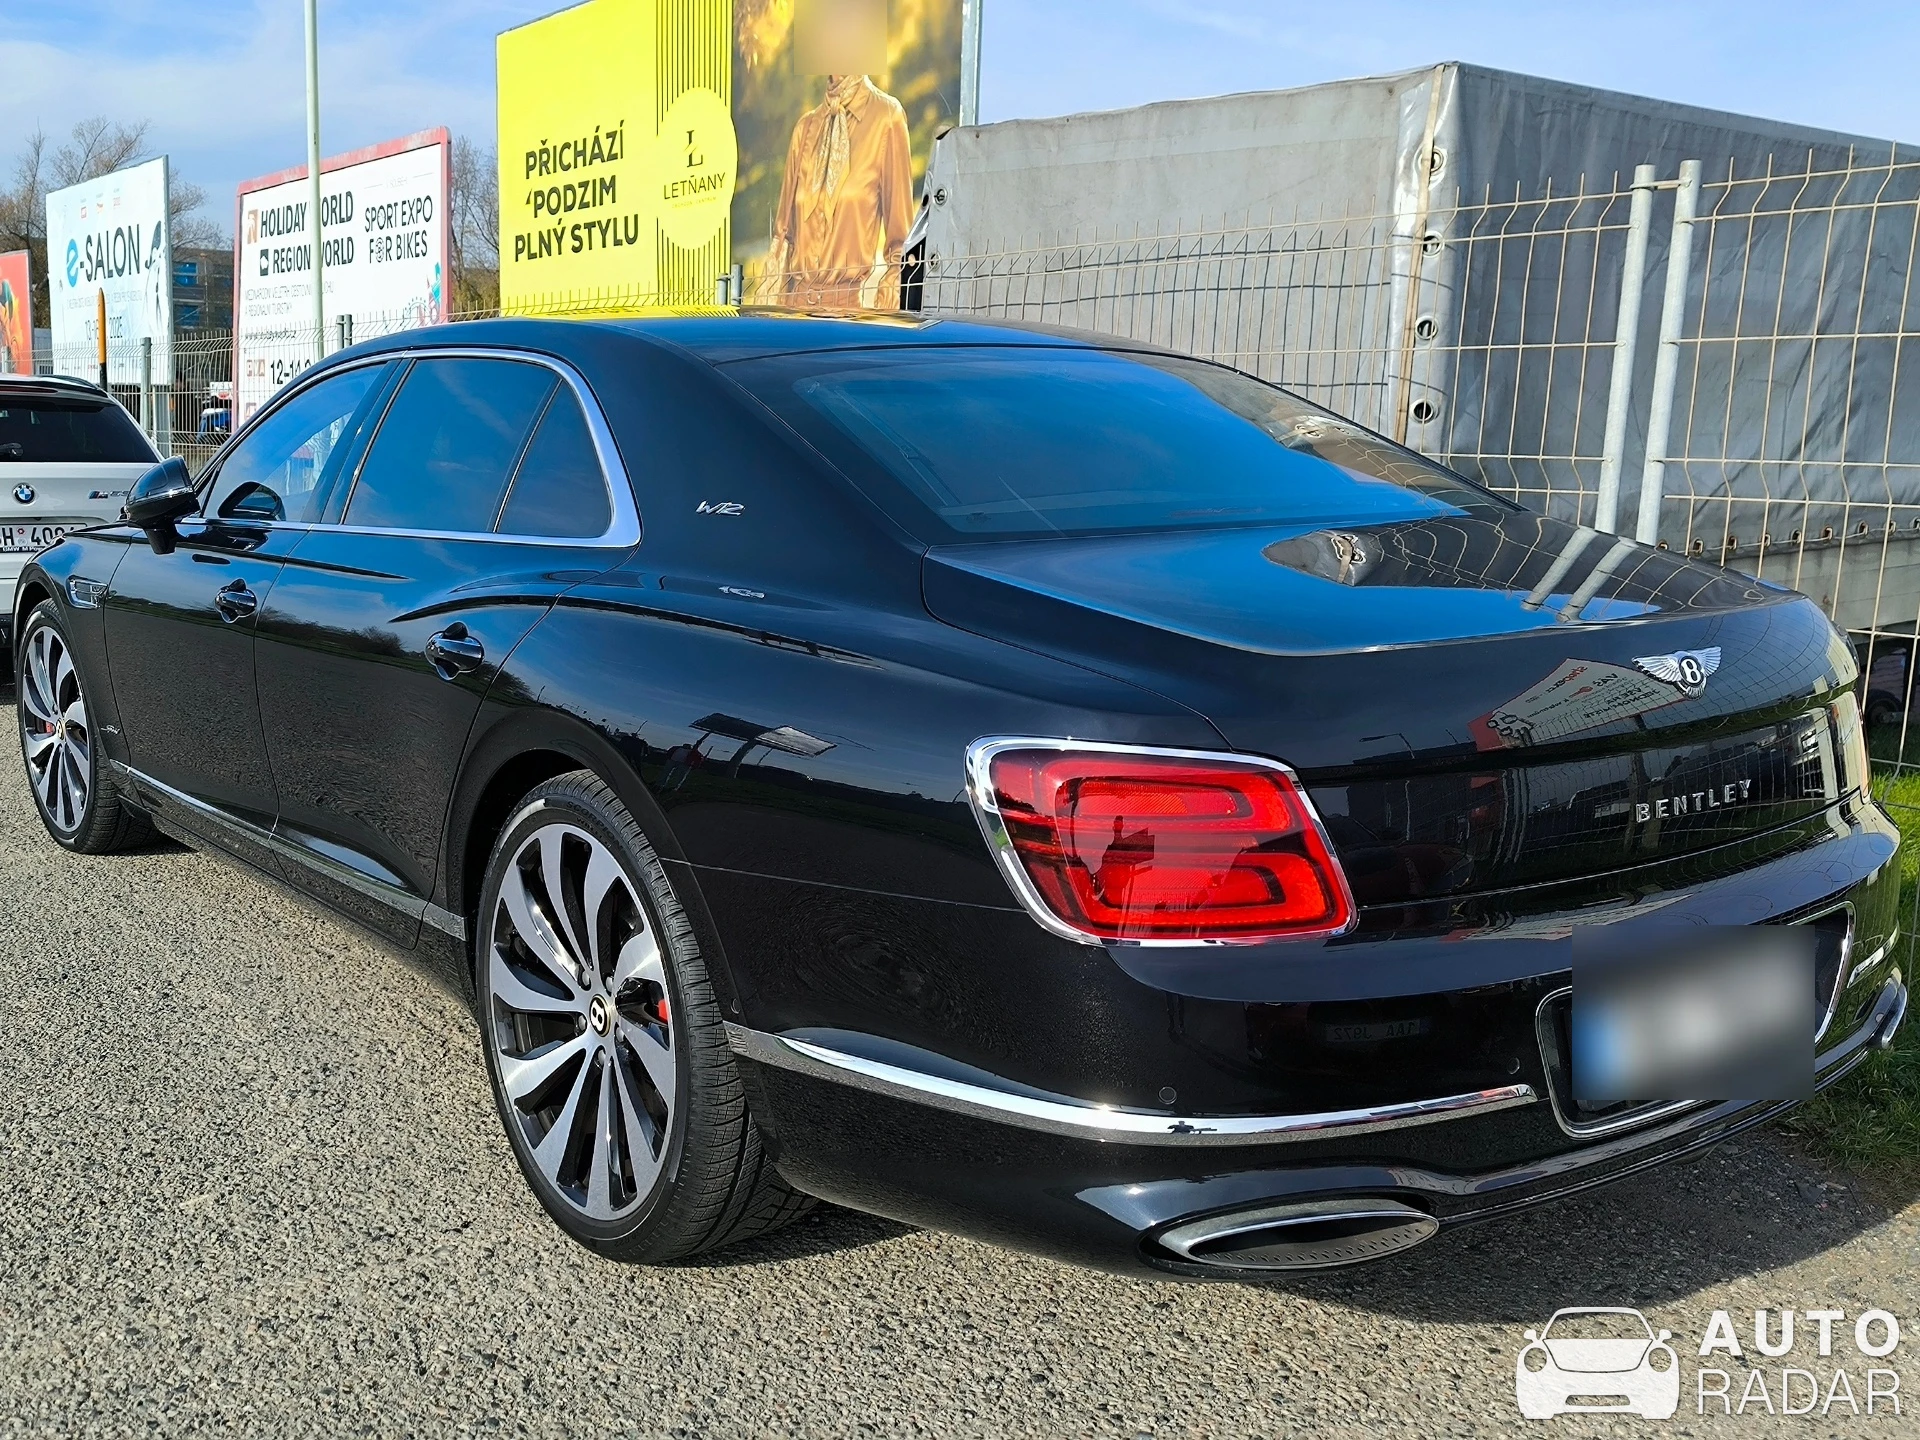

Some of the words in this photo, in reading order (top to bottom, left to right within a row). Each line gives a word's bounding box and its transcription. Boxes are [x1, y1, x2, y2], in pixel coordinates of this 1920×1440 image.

[526, 119, 625, 179] PŘICHÁZÍ
[663, 172, 726, 199] LETŇANY
[260, 201, 307, 238] HOLIDAY
[320, 190, 354, 228] ORLD
[364, 202, 398, 233] SPORT
[401, 194, 433, 227] EXPO
[66, 223, 141, 288] e-SALON
[272, 243, 311, 274] REGION
[396, 229, 428, 260] BIKES
[515, 217, 566, 262] PLNÝ
[570, 213, 639, 253] STYLU
[0, 527, 15, 546] H
[1635, 779, 1753, 824] BENTLEY
